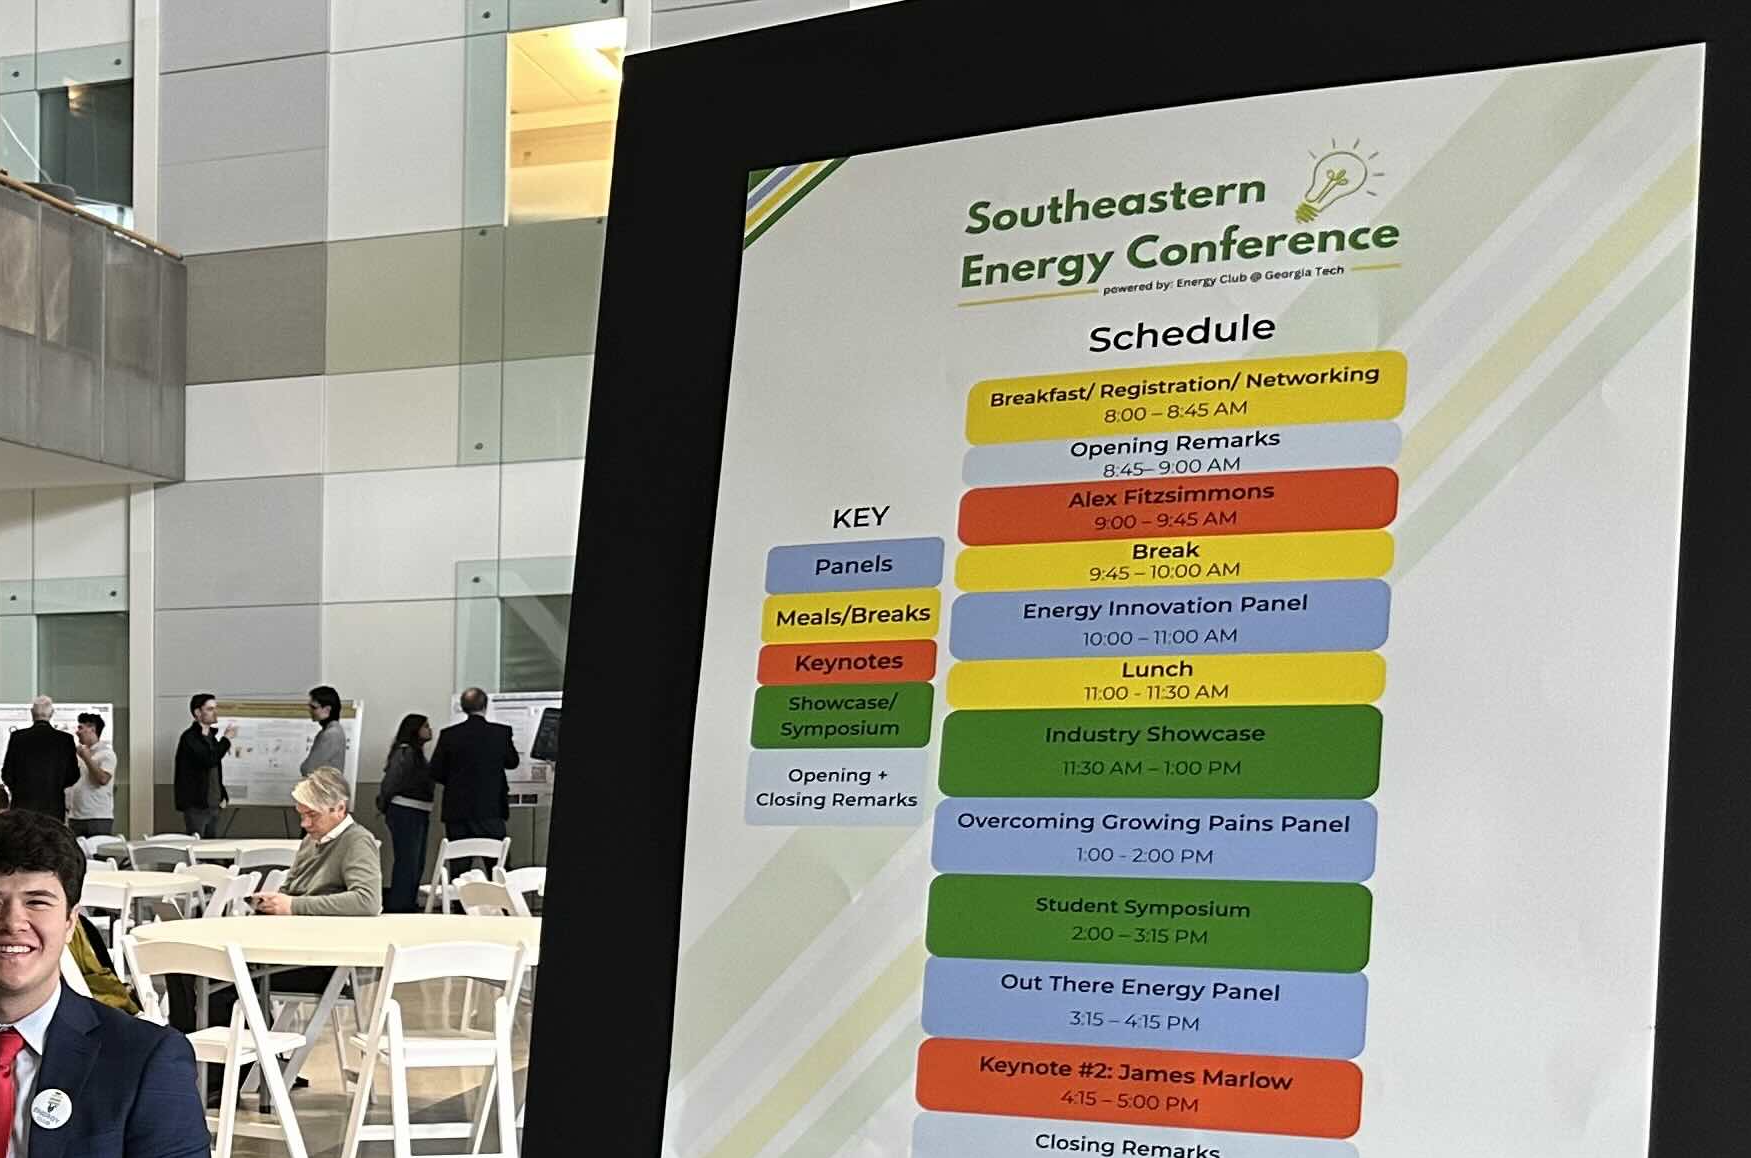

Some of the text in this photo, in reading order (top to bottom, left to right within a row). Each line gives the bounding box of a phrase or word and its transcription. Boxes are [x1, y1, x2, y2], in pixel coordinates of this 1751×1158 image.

[964, 179, 1266, 235] Southeastern
[960, 224, 1400, 288] Energy Conference
[1103, 281, 1152, 296] powered
[1176, 274, 1216, 288] Energy
[1219, 272, 1248, 285] Club
[1264, 267, 1312, 281] Georgia
[1314, 264, 1345, 277] Tech
[1089, 314, 1276, 353] Schedule
[990, 366, 1380, 408] Breakfast/ Registration/ Networking
[1104, 407, 1147, 424] 8:00
[1166, 402, 1210, 419] 8:45
[1213, 400, 1249, 416] AM
[1070, 431, 1281, 459] Opening Remarks
[1158, 458, 1202, 475] 9:00
[1207, 456, 1241, 473] AM
[1069, 483, 1275, 510] Alex Fitzsimmons
[833, 505, 890, 529] KEY
[1094, 514, 1137, 531] 9:00
[1156, 512, 1199, 529] 9:45
[1202, 511, 1238, 527] AM
[1132, 541, 1200, 561] Break
[815, 555, 893, 576] Panels
[1090, 565, 1131, 582] 9:45
[1150, 562, 1202, 580] 10:00
[1206, 561, 1241, 578] AM
[776, 604, 931, 627] Meals/Breaks
[1023, 594, 1308, 622] Energy Innovation Panel
[1083, 630, 1133, 647] 10:00
[1153, 628, 1199, 645] 11:00
[1204, 627, 1238, 643] AM
[795, 653, 903, 675] Keynotes
[1122, 660, 1193, 679] Lunch
[789, 692, 899, 711] Showcase/
[1084, 685, 1129, 701] 11:00
[1147, 683, 1190, 700] 11:30
[1194, 683, 1229, 699] AM
[781, 720, 900, 740] Symposium
[1046, 724, 1266, 746] Industry Showcase
[788, 768, 871, 785] Opening
[1063, 760, 1105, 777] 11:30
[1110, 760, 1143, 776] AM
[1164, 760, 1203, 776] 1:00
[1210, 760, 1242, 776] PM
[756, 792, 918, 810] Closing Remarks
[957, 812, 1350, 835] Overcoming Growing Pains Panel
[1076, 846, 1114, 863] 1:00
[1131, 847, 1175, 864] 2:00
[1180, 848, 1214, 865] PM
[1036, 897, 1251, 919] Student Symposium
[1071, 925, 1114, 942] 2:00
[1134, 927, 1170, 944] 3:15
[1175, 928, 1209, 945] PM
[1001, 973, 1281, 1002] Out There Energy Panel
[1070, 1010, 1105, 1027] 3:15
[1125, 1012, 1162, 1030] 4:15
[1167, 1015, 1200, 1032] PM
[980, 1055, 1294, 1091] Keynote #2: James Marlow
[1060, 1090, 1097, 1107] 4:15
[1117, 1092, 1160, 1111] 5:00
[1166, 1095, 1199, 1113] PM
[1035, 1134, 1115, 1157] Closing
